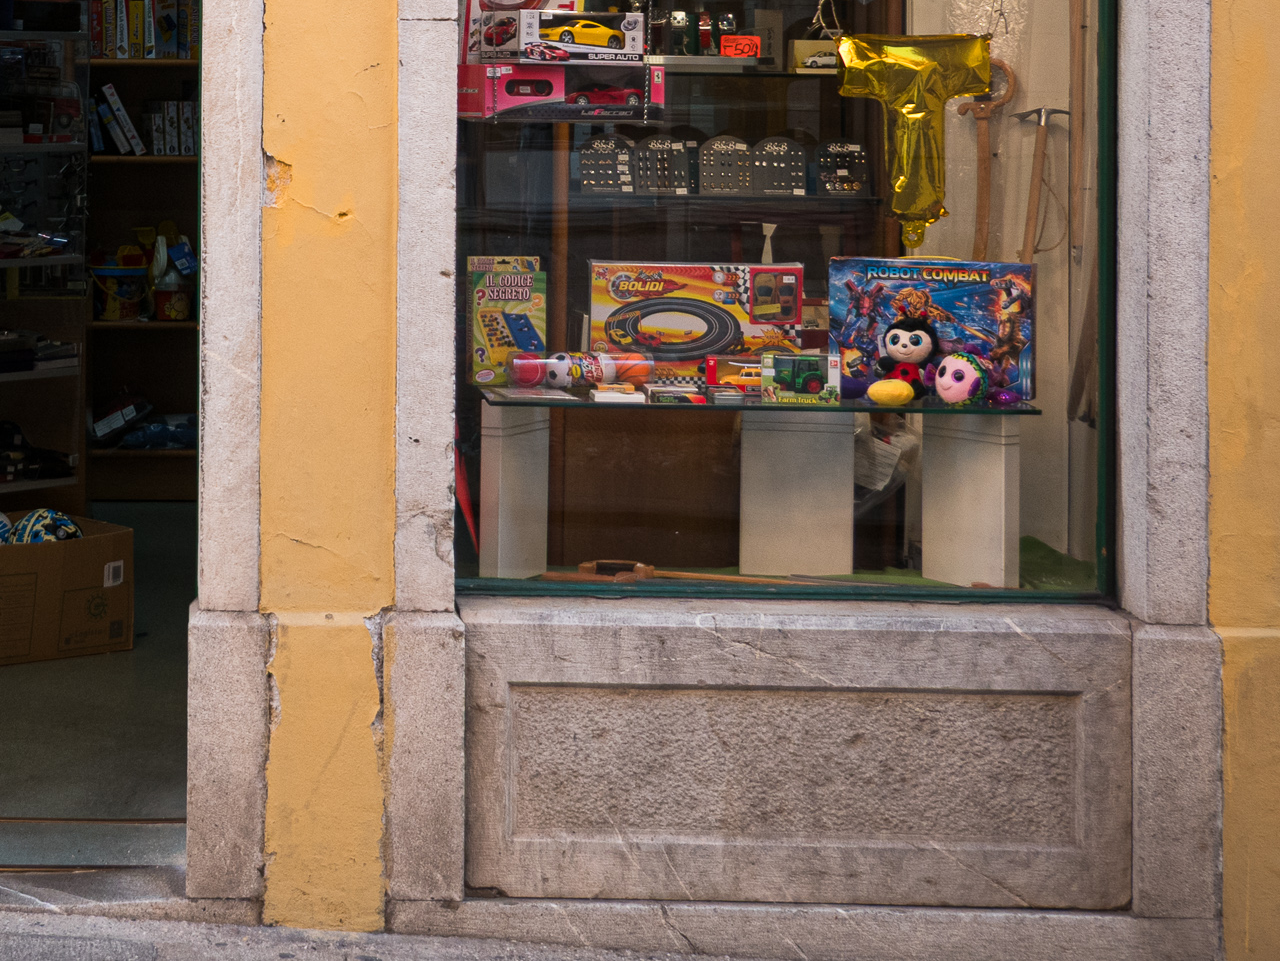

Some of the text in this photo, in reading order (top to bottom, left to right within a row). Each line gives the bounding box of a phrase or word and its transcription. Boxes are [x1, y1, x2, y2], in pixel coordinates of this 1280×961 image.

[616, 53, 639, 61] AUTO
[580, 108, 634, 116] LaFerrari
[866, 266, 990, 283] ROBOT COMBAT
[485, 274, 534, 287] IL CODICE
[618, 281, 665, 291] BOLIDI
[487, 287, 531, 301] SEGRETO
